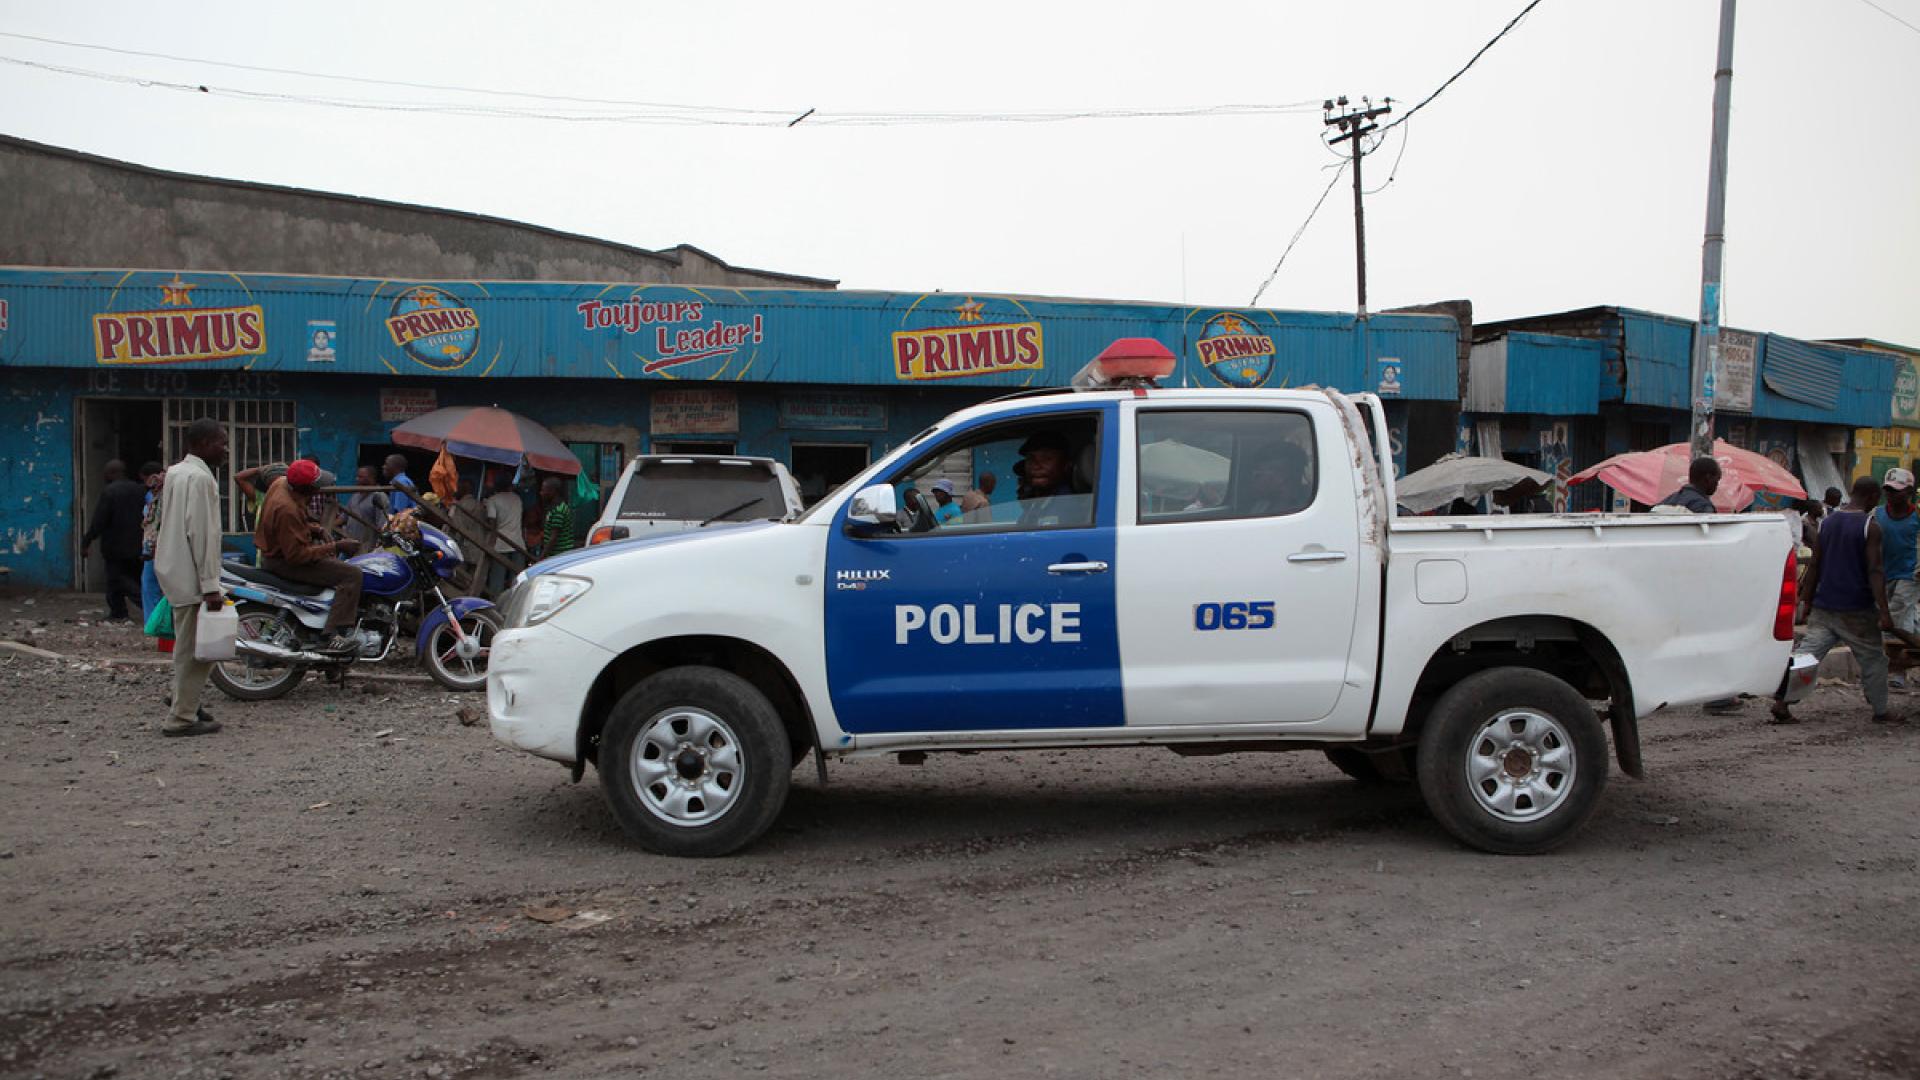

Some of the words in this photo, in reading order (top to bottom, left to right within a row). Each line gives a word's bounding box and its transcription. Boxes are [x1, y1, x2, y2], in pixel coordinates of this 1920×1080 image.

[390, 309, 477, 344] PRIMUS
[578, 295, 703, 333] Toujours
[96, 311, 262, 361] PRIMUS
[656, 314, 763, 355] Leader!
[896, 326, 1040, 375] PRIMUS
[1199, 335, 1273, 365] PRIMUS
[836, 569, 891, 580] HILUX
[895, 603, 1081, 645] POLICE
[1195, 601, 1275, 630] 065
